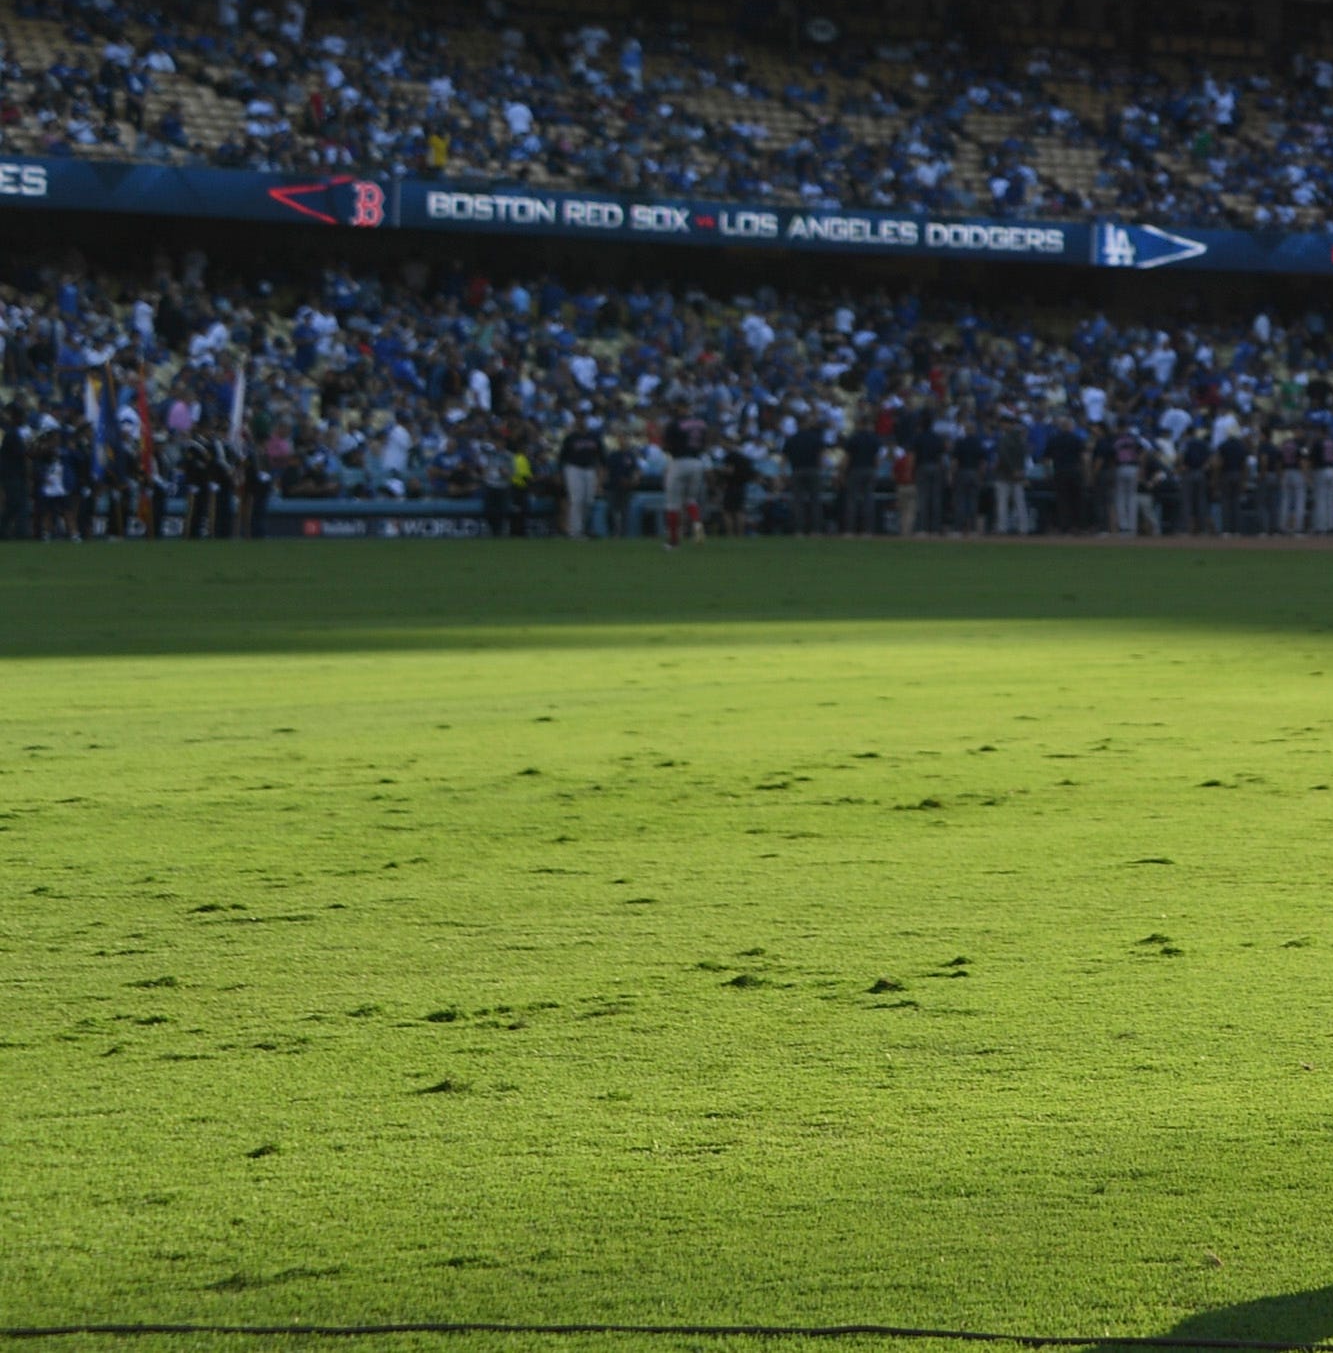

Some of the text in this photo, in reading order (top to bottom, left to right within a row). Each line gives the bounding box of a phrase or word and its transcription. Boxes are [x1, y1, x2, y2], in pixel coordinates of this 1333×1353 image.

[350, 180, 385, 227] B
[426, 190, 556, 223] BOSTON
[563, 199, 624, 229] RED
[630, 204, 690, 233] SOX
[719, 210, 778, 238] LOS
[787, 217, 919, 246] ANGELES
[925, 222, 1064, 253] DODGERS
[1103, 223, 1137, 266] LA
